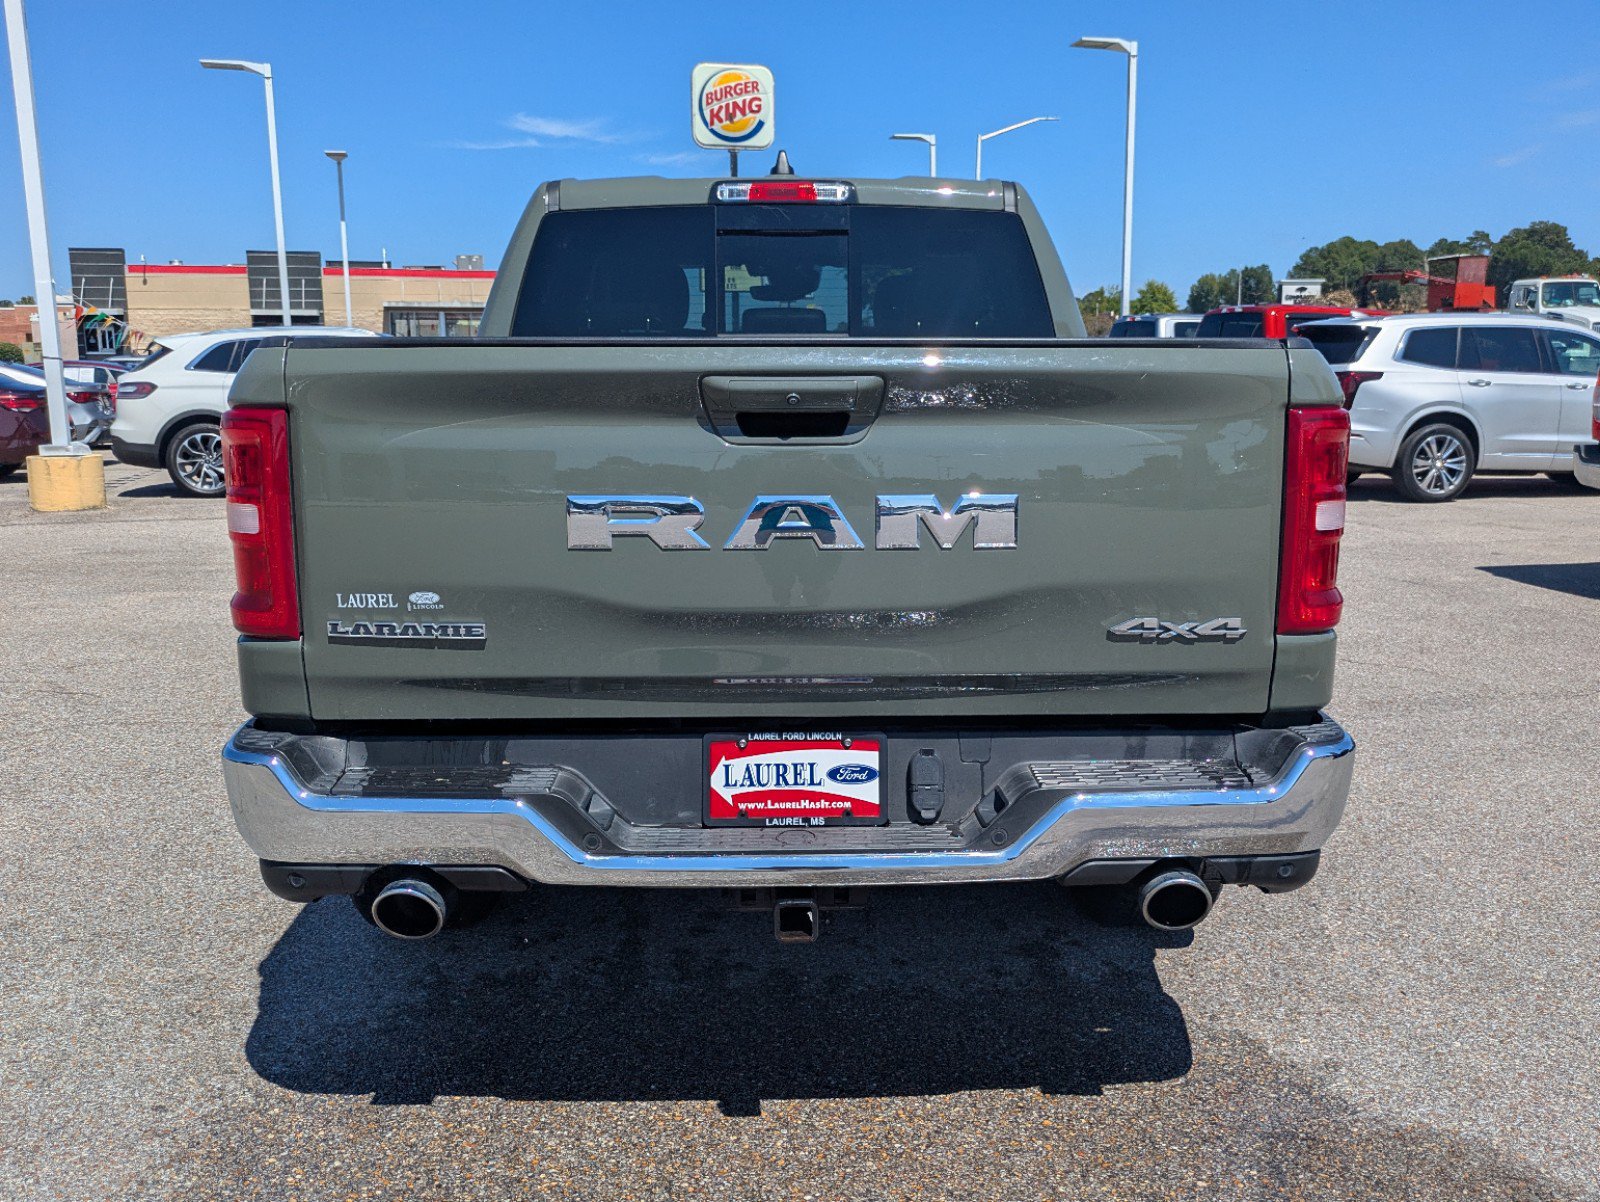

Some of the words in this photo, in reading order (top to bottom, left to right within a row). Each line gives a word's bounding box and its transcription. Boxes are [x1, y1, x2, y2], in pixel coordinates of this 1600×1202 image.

[705, 81, 760, 107] BURGER
[709, 96, 762, 127] KING
[567, 494, 1019, 551] RAM
[336, 593, 399, 608] LAUREL
[327, 620, 486, 639] LARAMIE
[748, 732, 781, 741] LAUREL
[783, 732, 805, 741] FORD
[807, 732, 842, 741] LINCOLN
[723, 762, 825, 787] LAUREL
[765, 817, 808, 826] LAUREL,
[810, 817, 825, 826] MS
